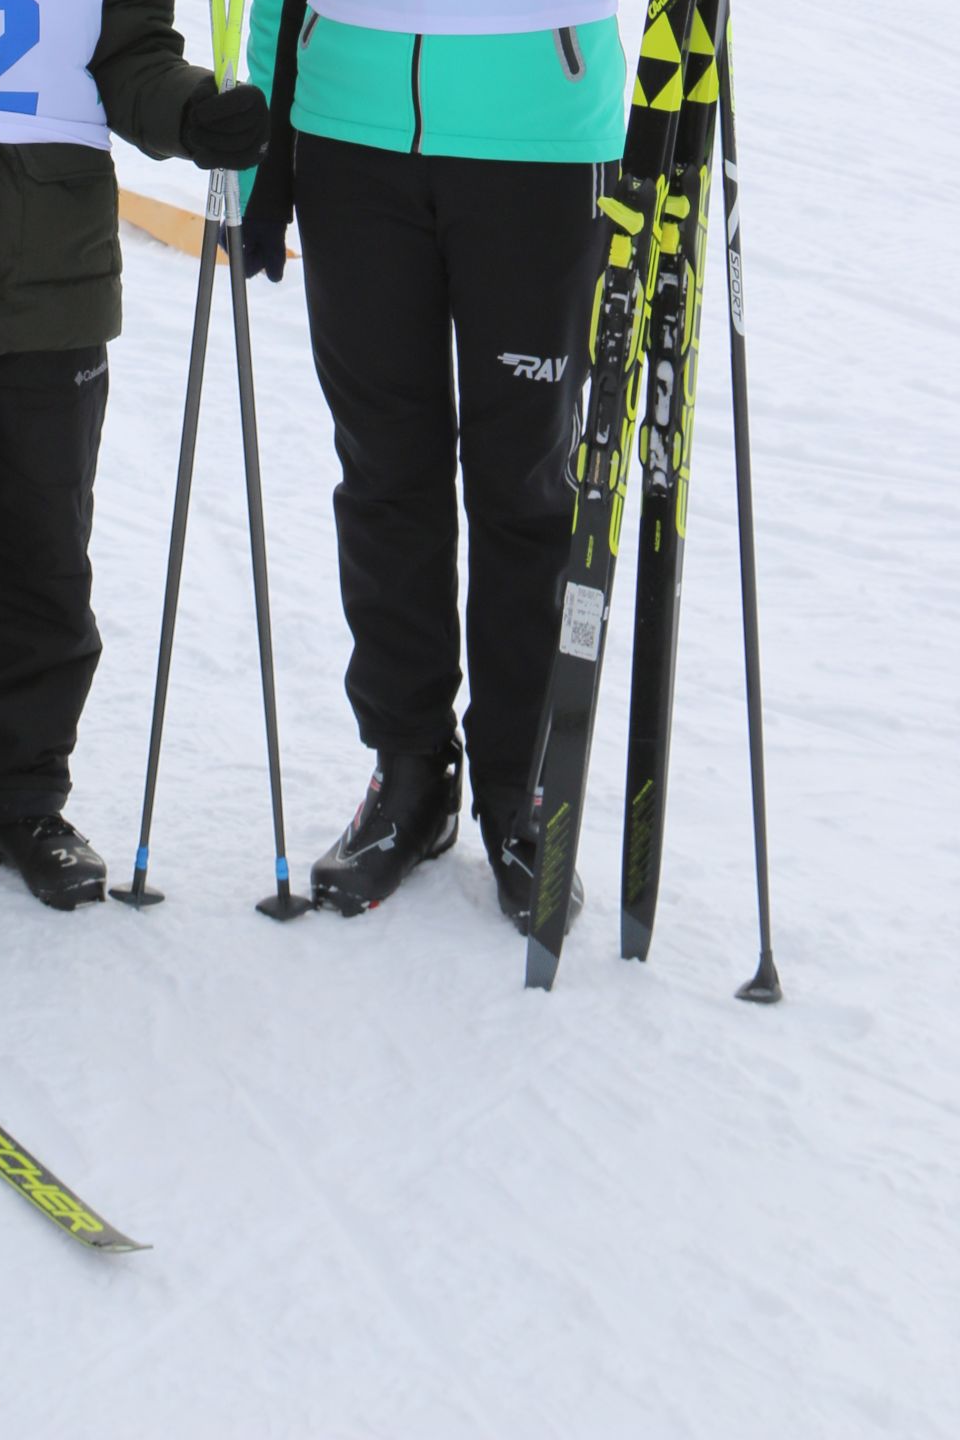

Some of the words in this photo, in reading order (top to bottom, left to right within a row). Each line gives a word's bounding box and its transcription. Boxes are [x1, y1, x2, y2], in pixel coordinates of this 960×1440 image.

[730, 251, 743, 321] SPORT
[498, 353, 568, 382] RAY
[52, 846, 103, 868] 35
